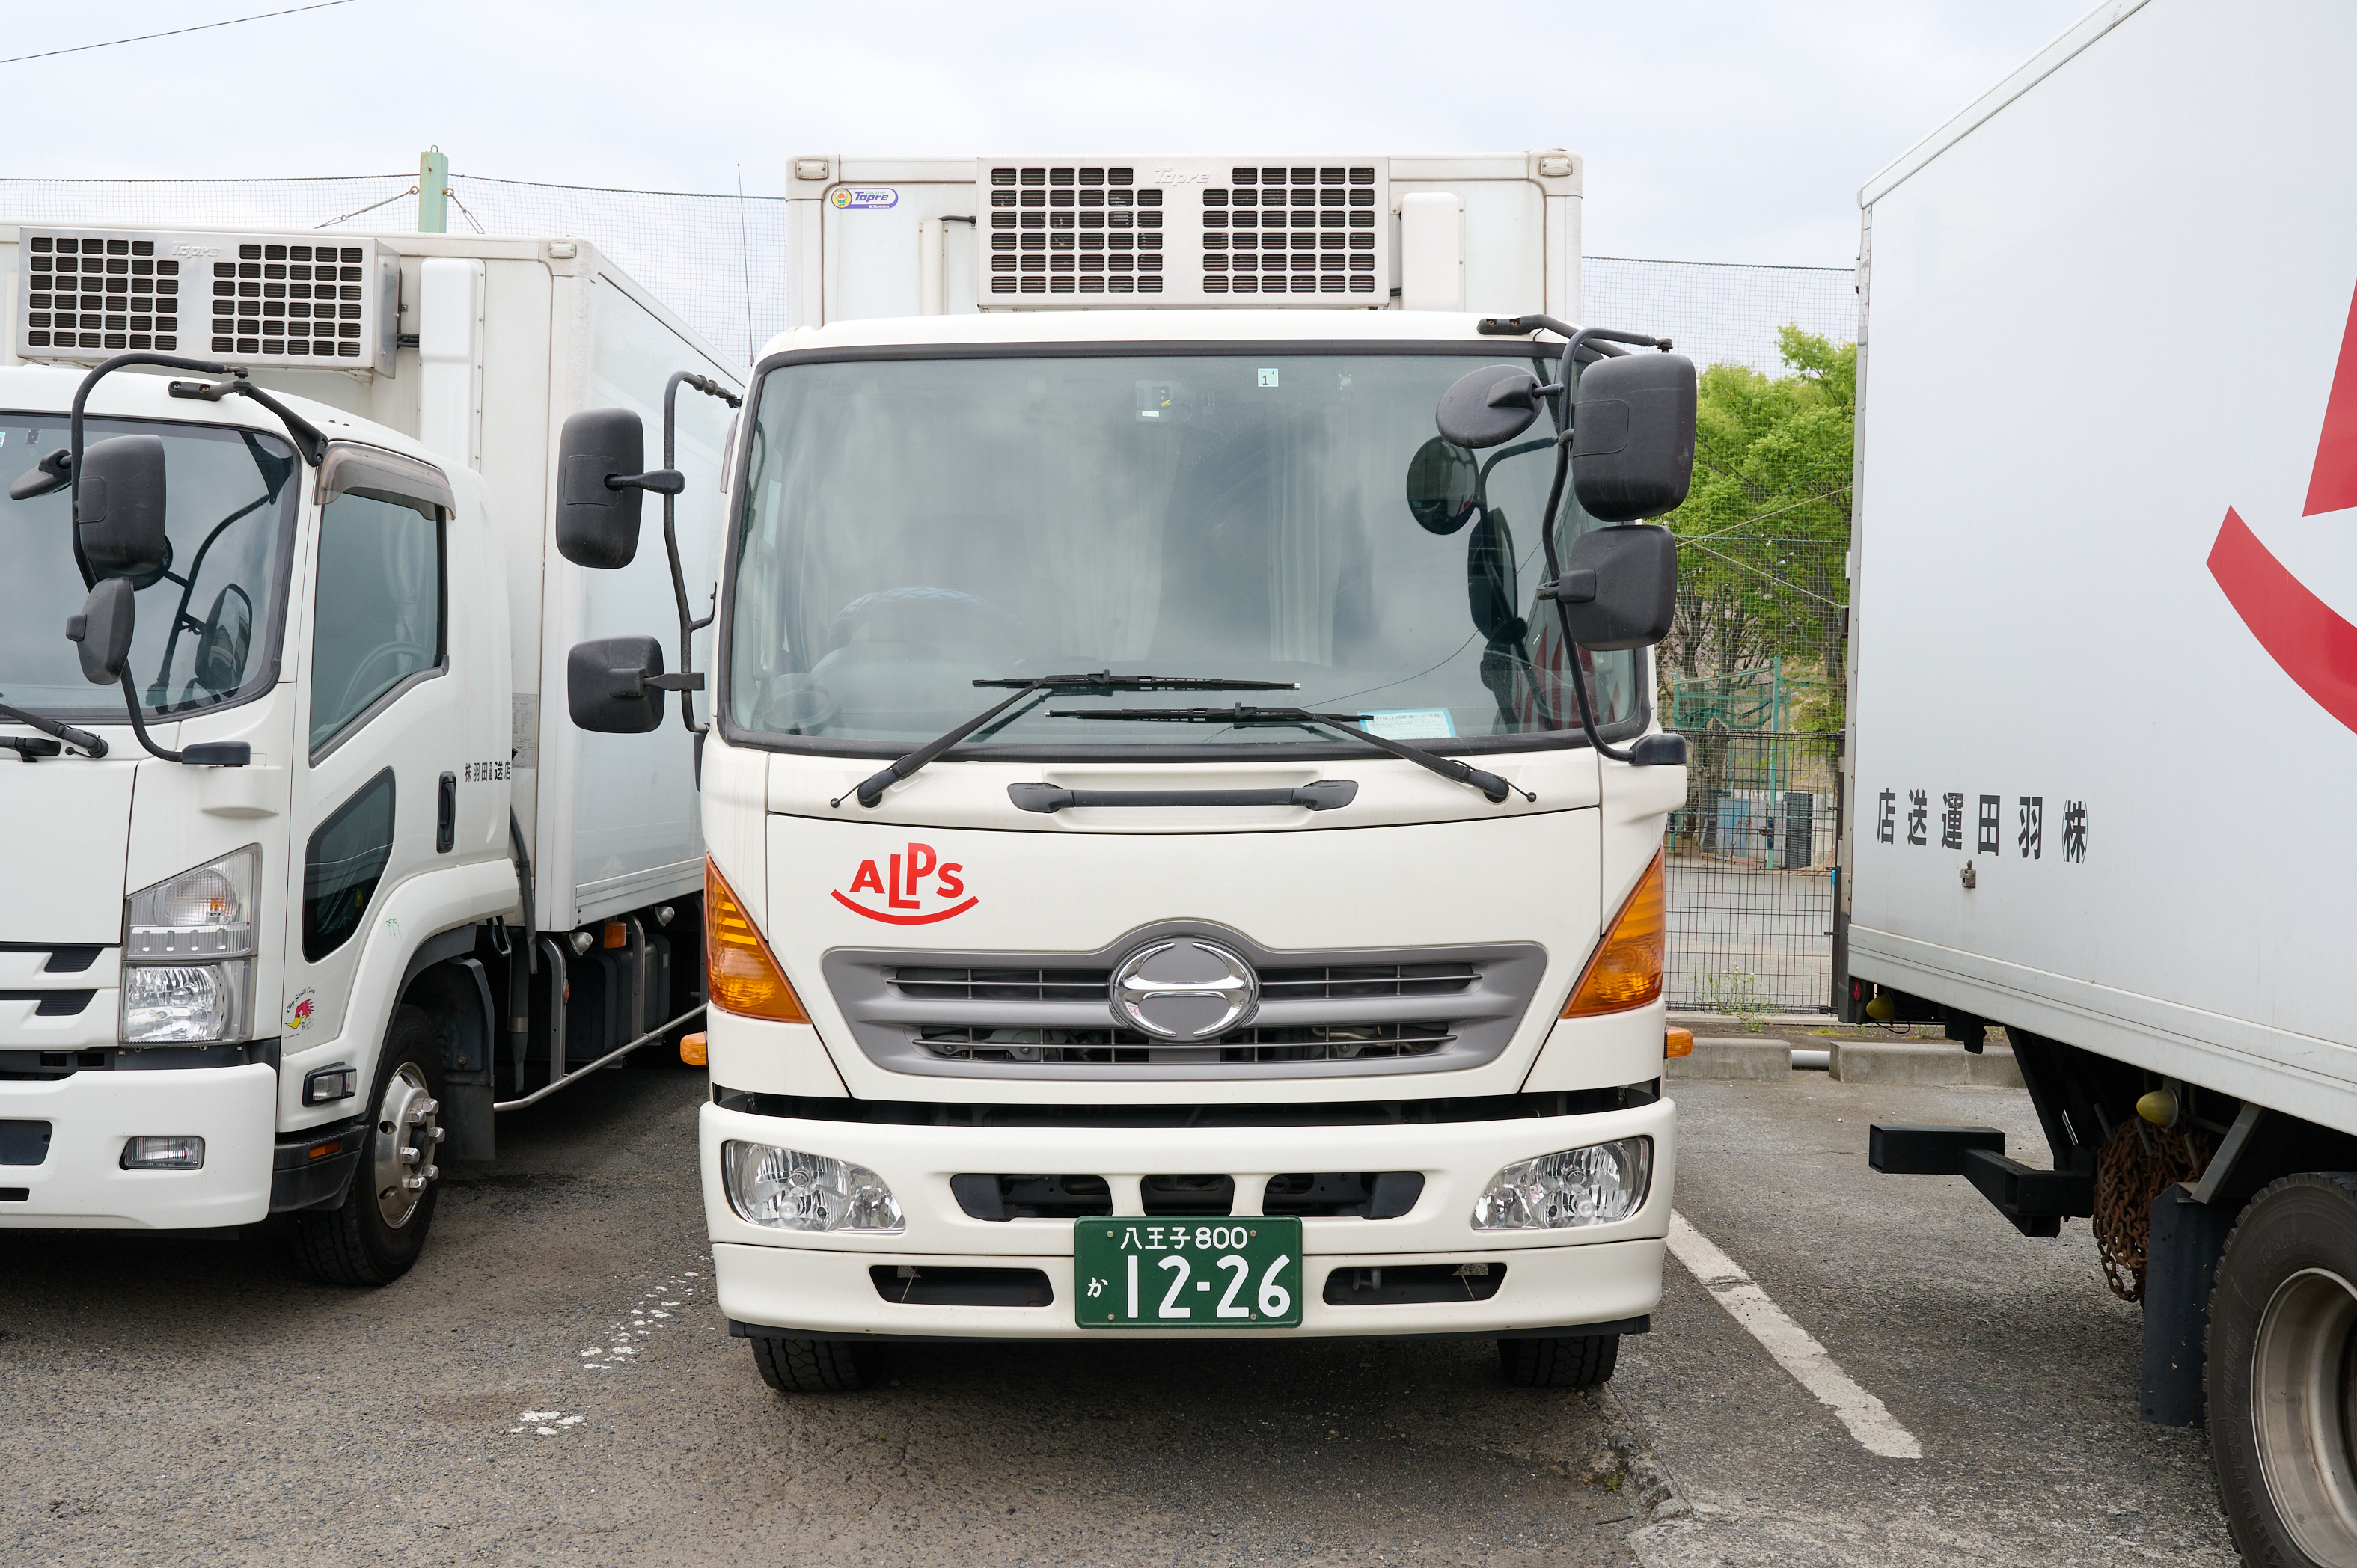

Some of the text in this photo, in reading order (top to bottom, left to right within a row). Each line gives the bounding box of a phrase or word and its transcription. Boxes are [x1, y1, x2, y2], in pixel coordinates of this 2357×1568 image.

[1155, 167, 1211, 186] Topre
[855, 191, 889, 203] Topre
[172, 241, 221, 259] Topre
[1262, 375, 1268, 385] 1
[849, 842, 964, 910] ALPS
[1087, 1254, 1291, 1319] か 12-26
